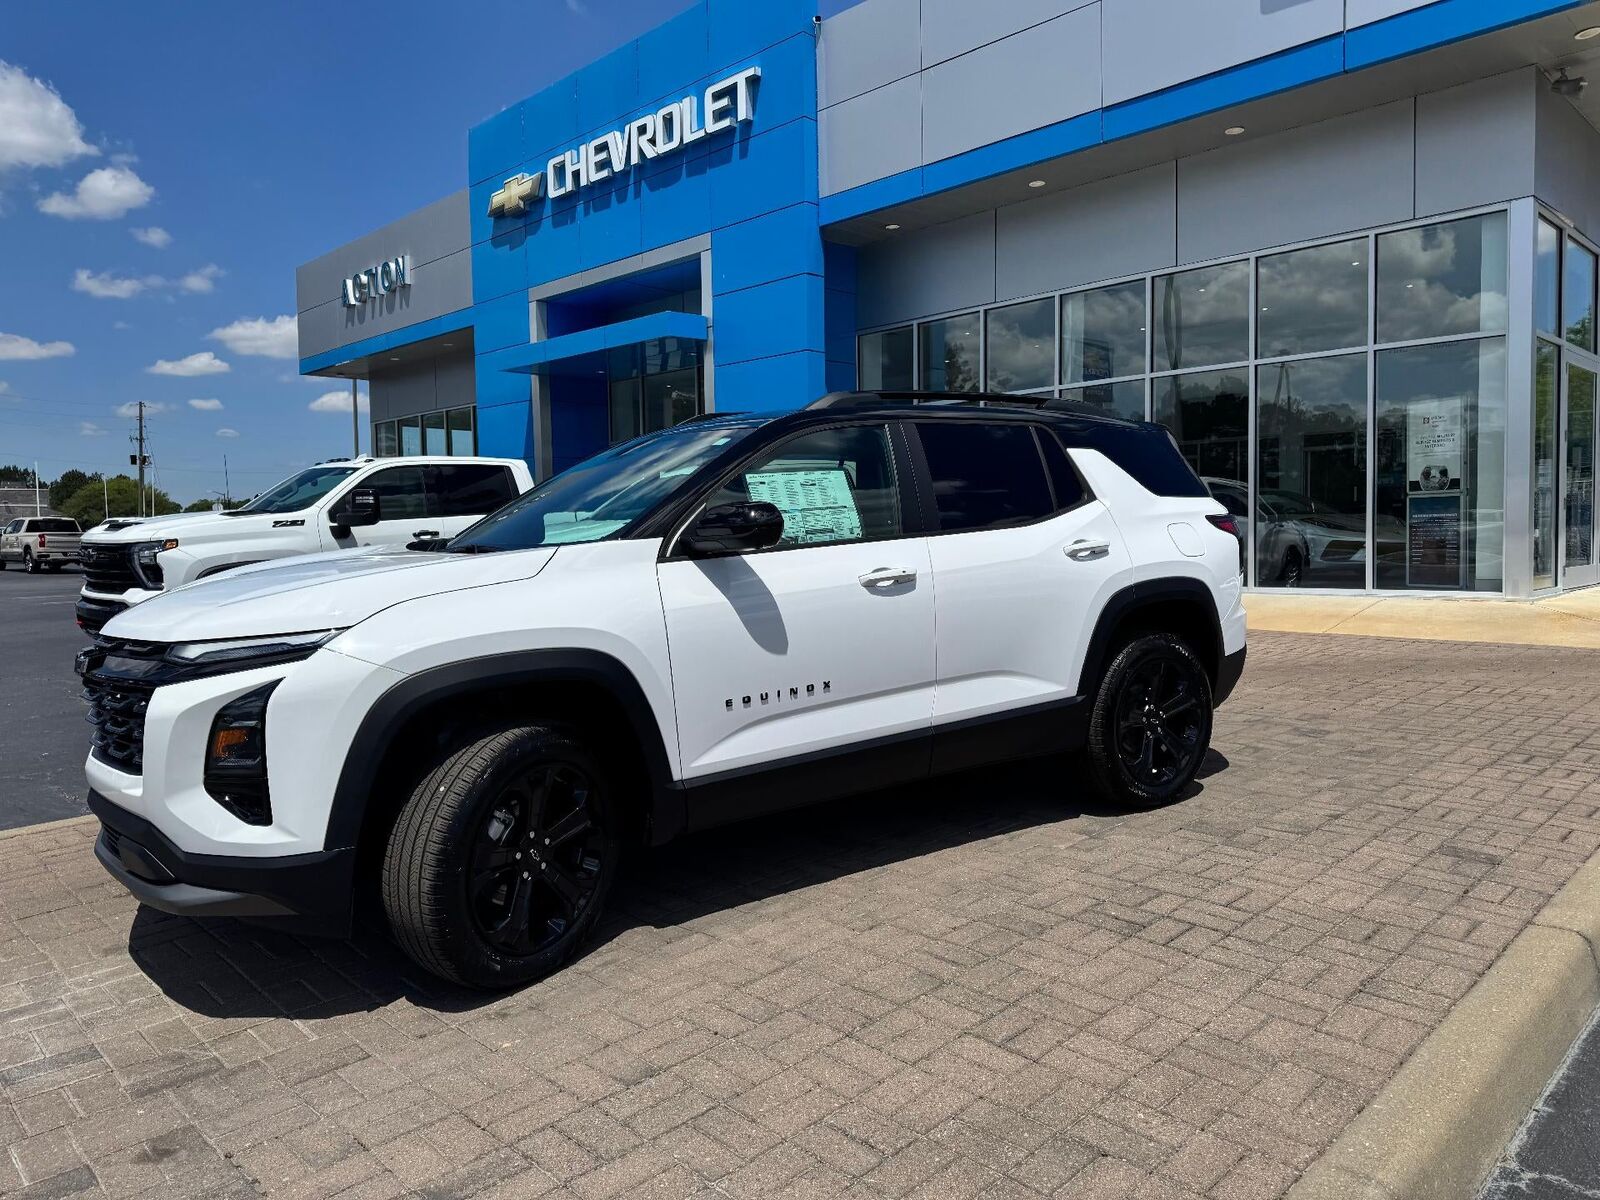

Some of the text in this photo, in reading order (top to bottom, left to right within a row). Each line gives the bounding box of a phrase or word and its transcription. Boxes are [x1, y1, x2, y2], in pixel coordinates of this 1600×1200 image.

[547, 66, 762, 199] CHEVROLET
[342, 255, 411, 307] ACTION
[725, 680, 831, 708] EQUINOX
